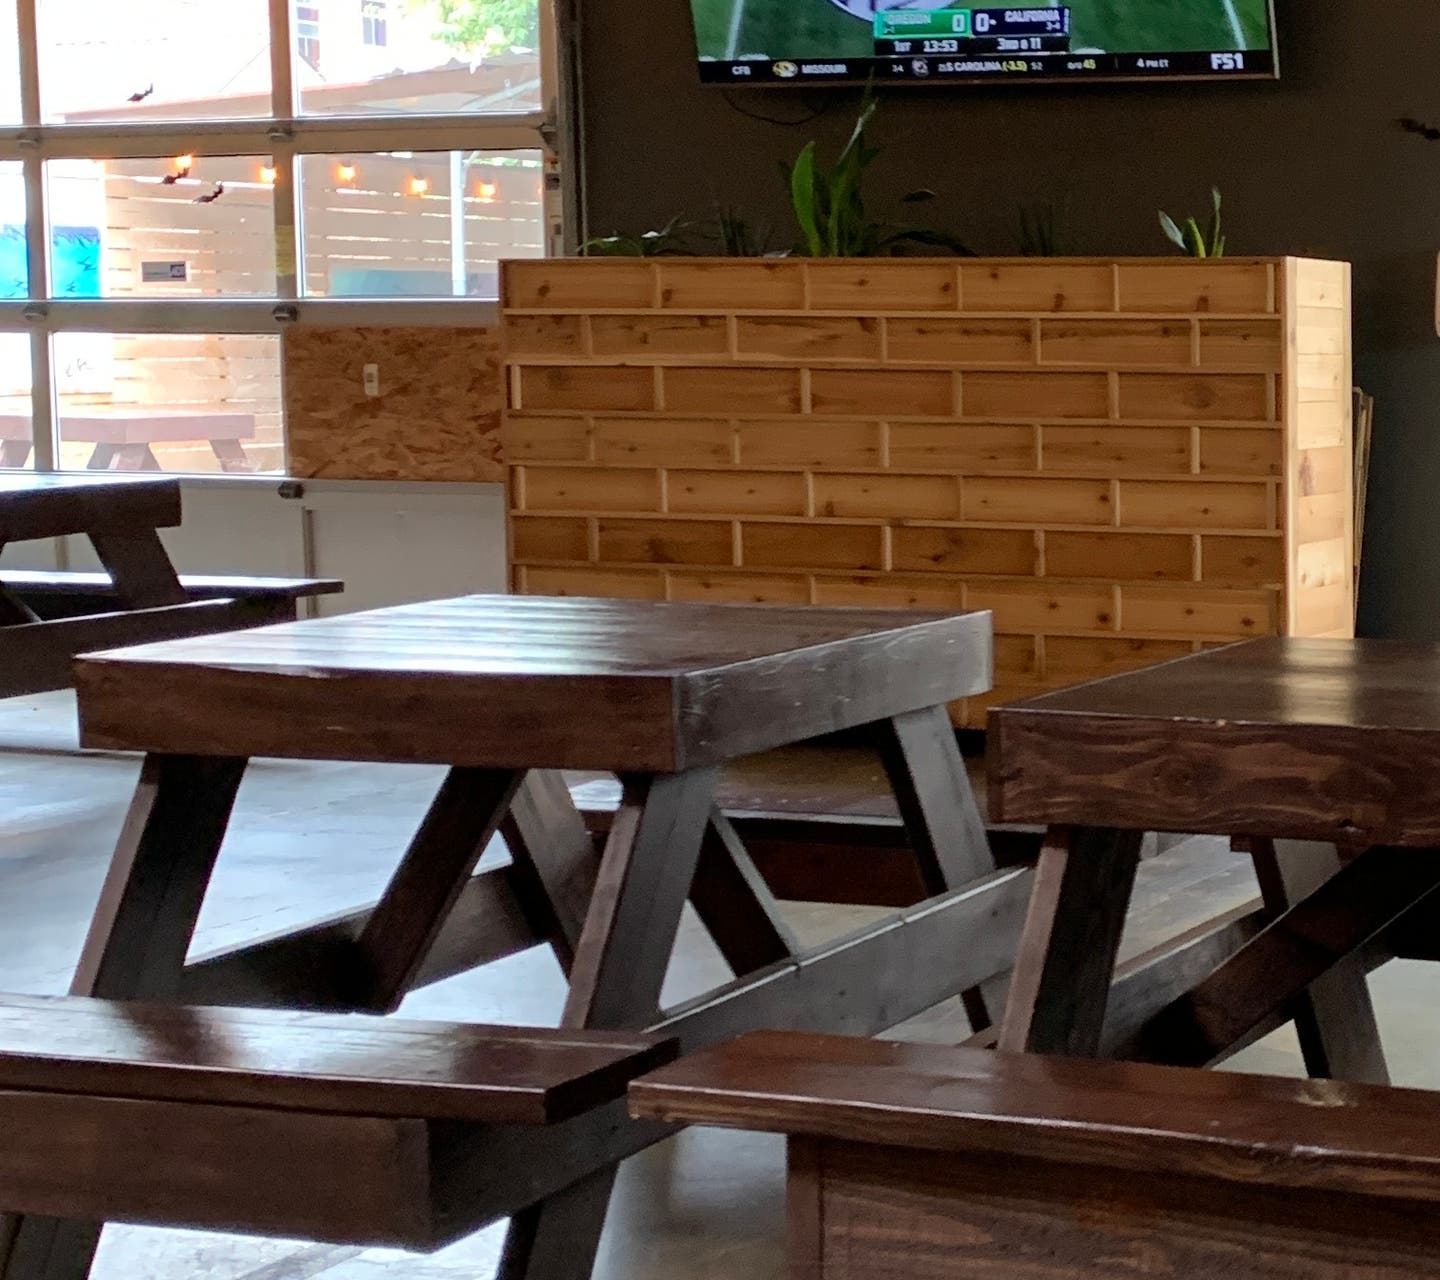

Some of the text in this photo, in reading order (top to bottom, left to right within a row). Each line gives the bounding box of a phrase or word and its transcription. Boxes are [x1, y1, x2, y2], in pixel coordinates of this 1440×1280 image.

[951, 14, 965, 32] 0
[975, 12, 990, 32] 0
[1004, 9, 1060, 22] CALIFORNIA
[923, 39, 958, 52] 13:53
[954, 61, 1002, 72] CAROLINA
[1210, 52, 1245, 70] FS1
